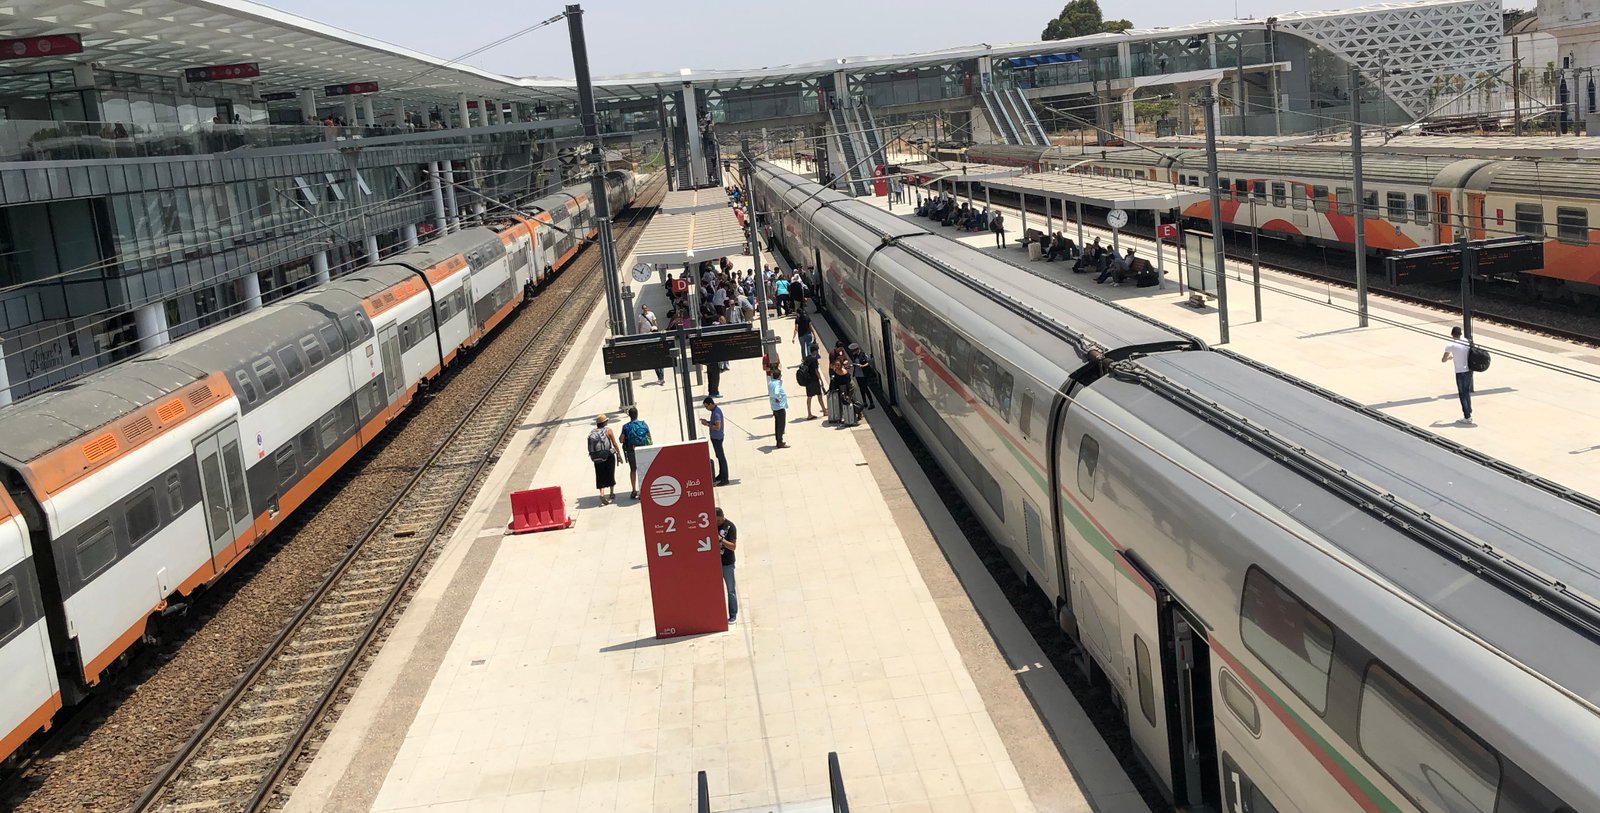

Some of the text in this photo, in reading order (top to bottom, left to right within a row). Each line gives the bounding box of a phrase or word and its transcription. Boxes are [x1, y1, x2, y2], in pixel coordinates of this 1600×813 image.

[1164, 225, 1171, 236] E
[677, 280, 687, 291] D
[664, 516, 677, 533] 2
[698, 512, 710, 528] 3
[1231, 771, 1244, 813] 1
